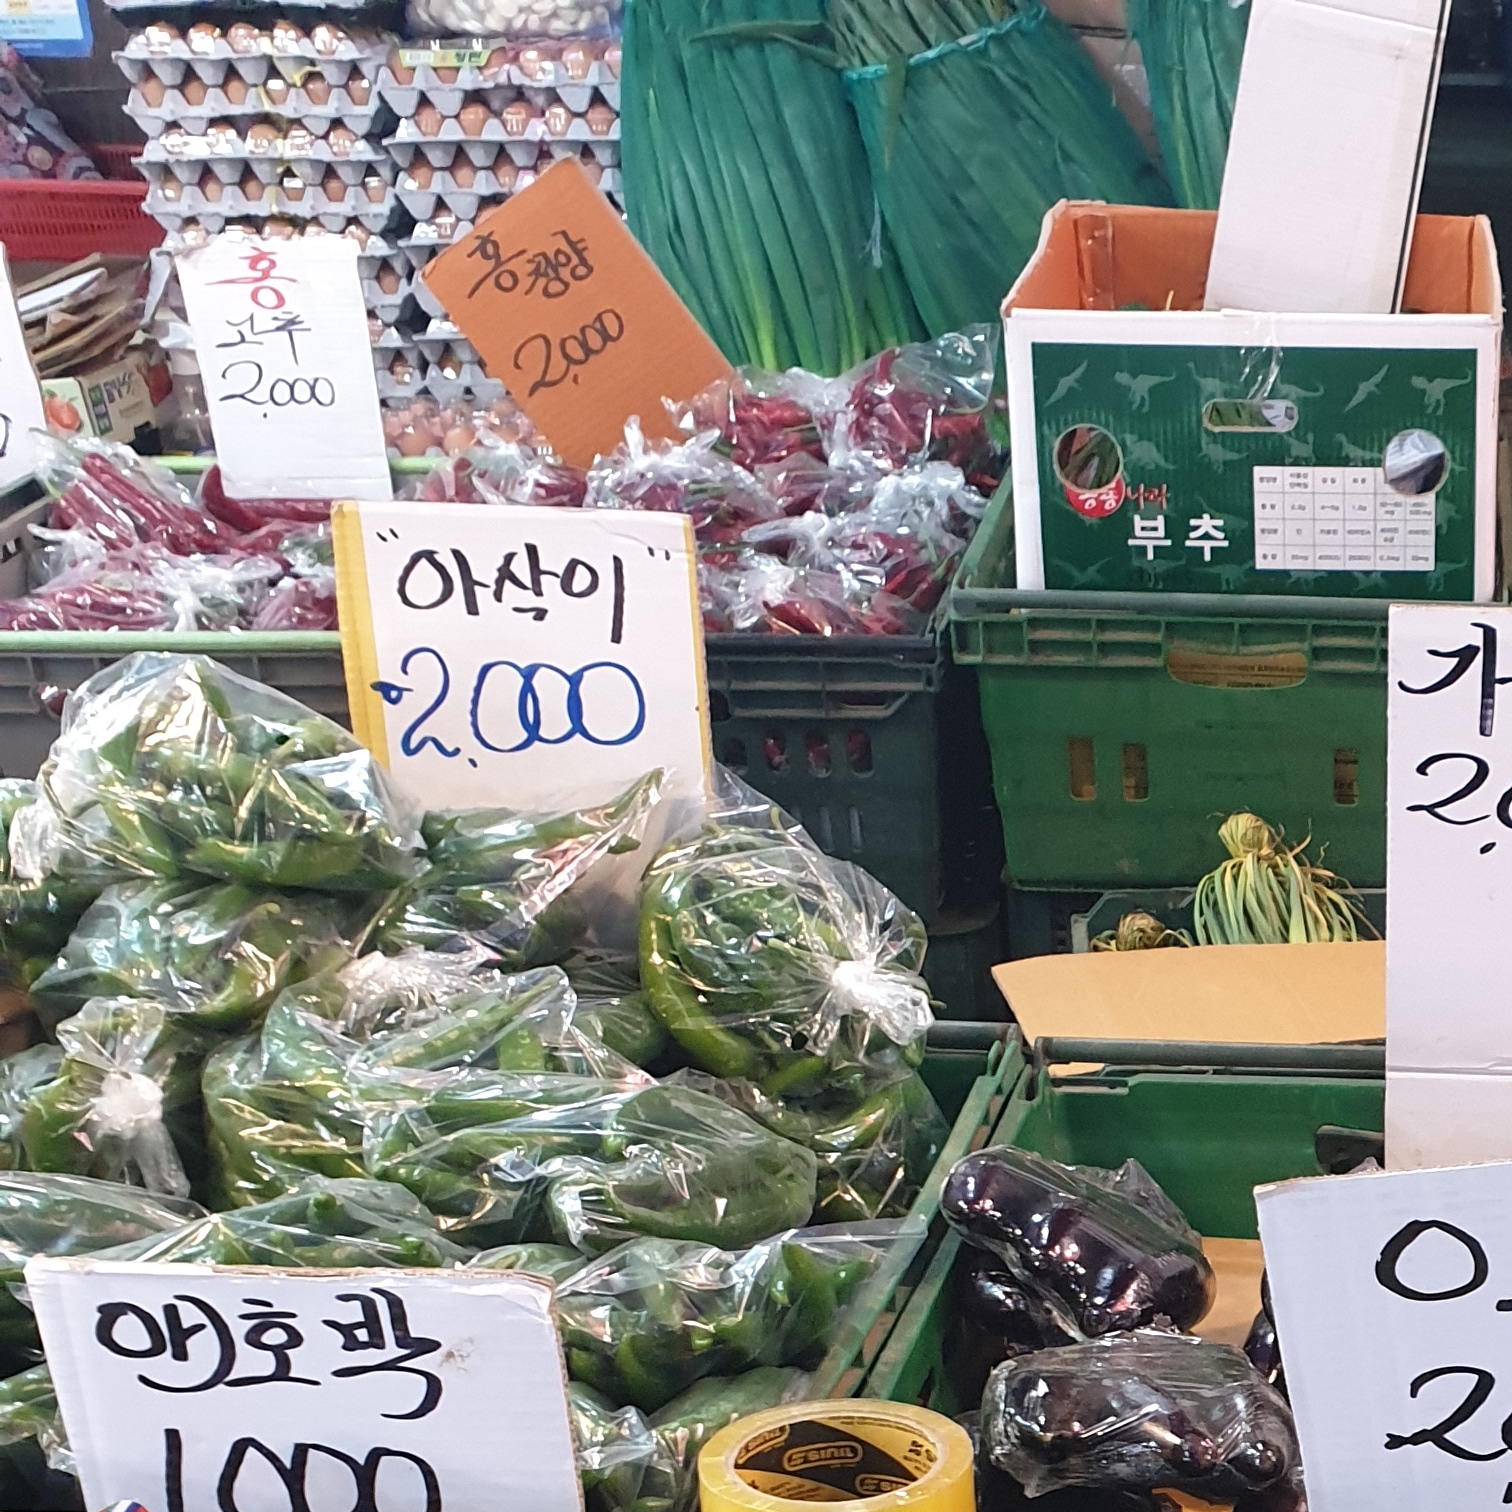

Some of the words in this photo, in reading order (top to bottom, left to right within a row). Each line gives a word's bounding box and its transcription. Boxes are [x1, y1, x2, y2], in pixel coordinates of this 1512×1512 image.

[204, 246, 298, 309] 홍
[215, 311, 312, 366] 고추
[95, 1286, 445, 1420] 애호박
